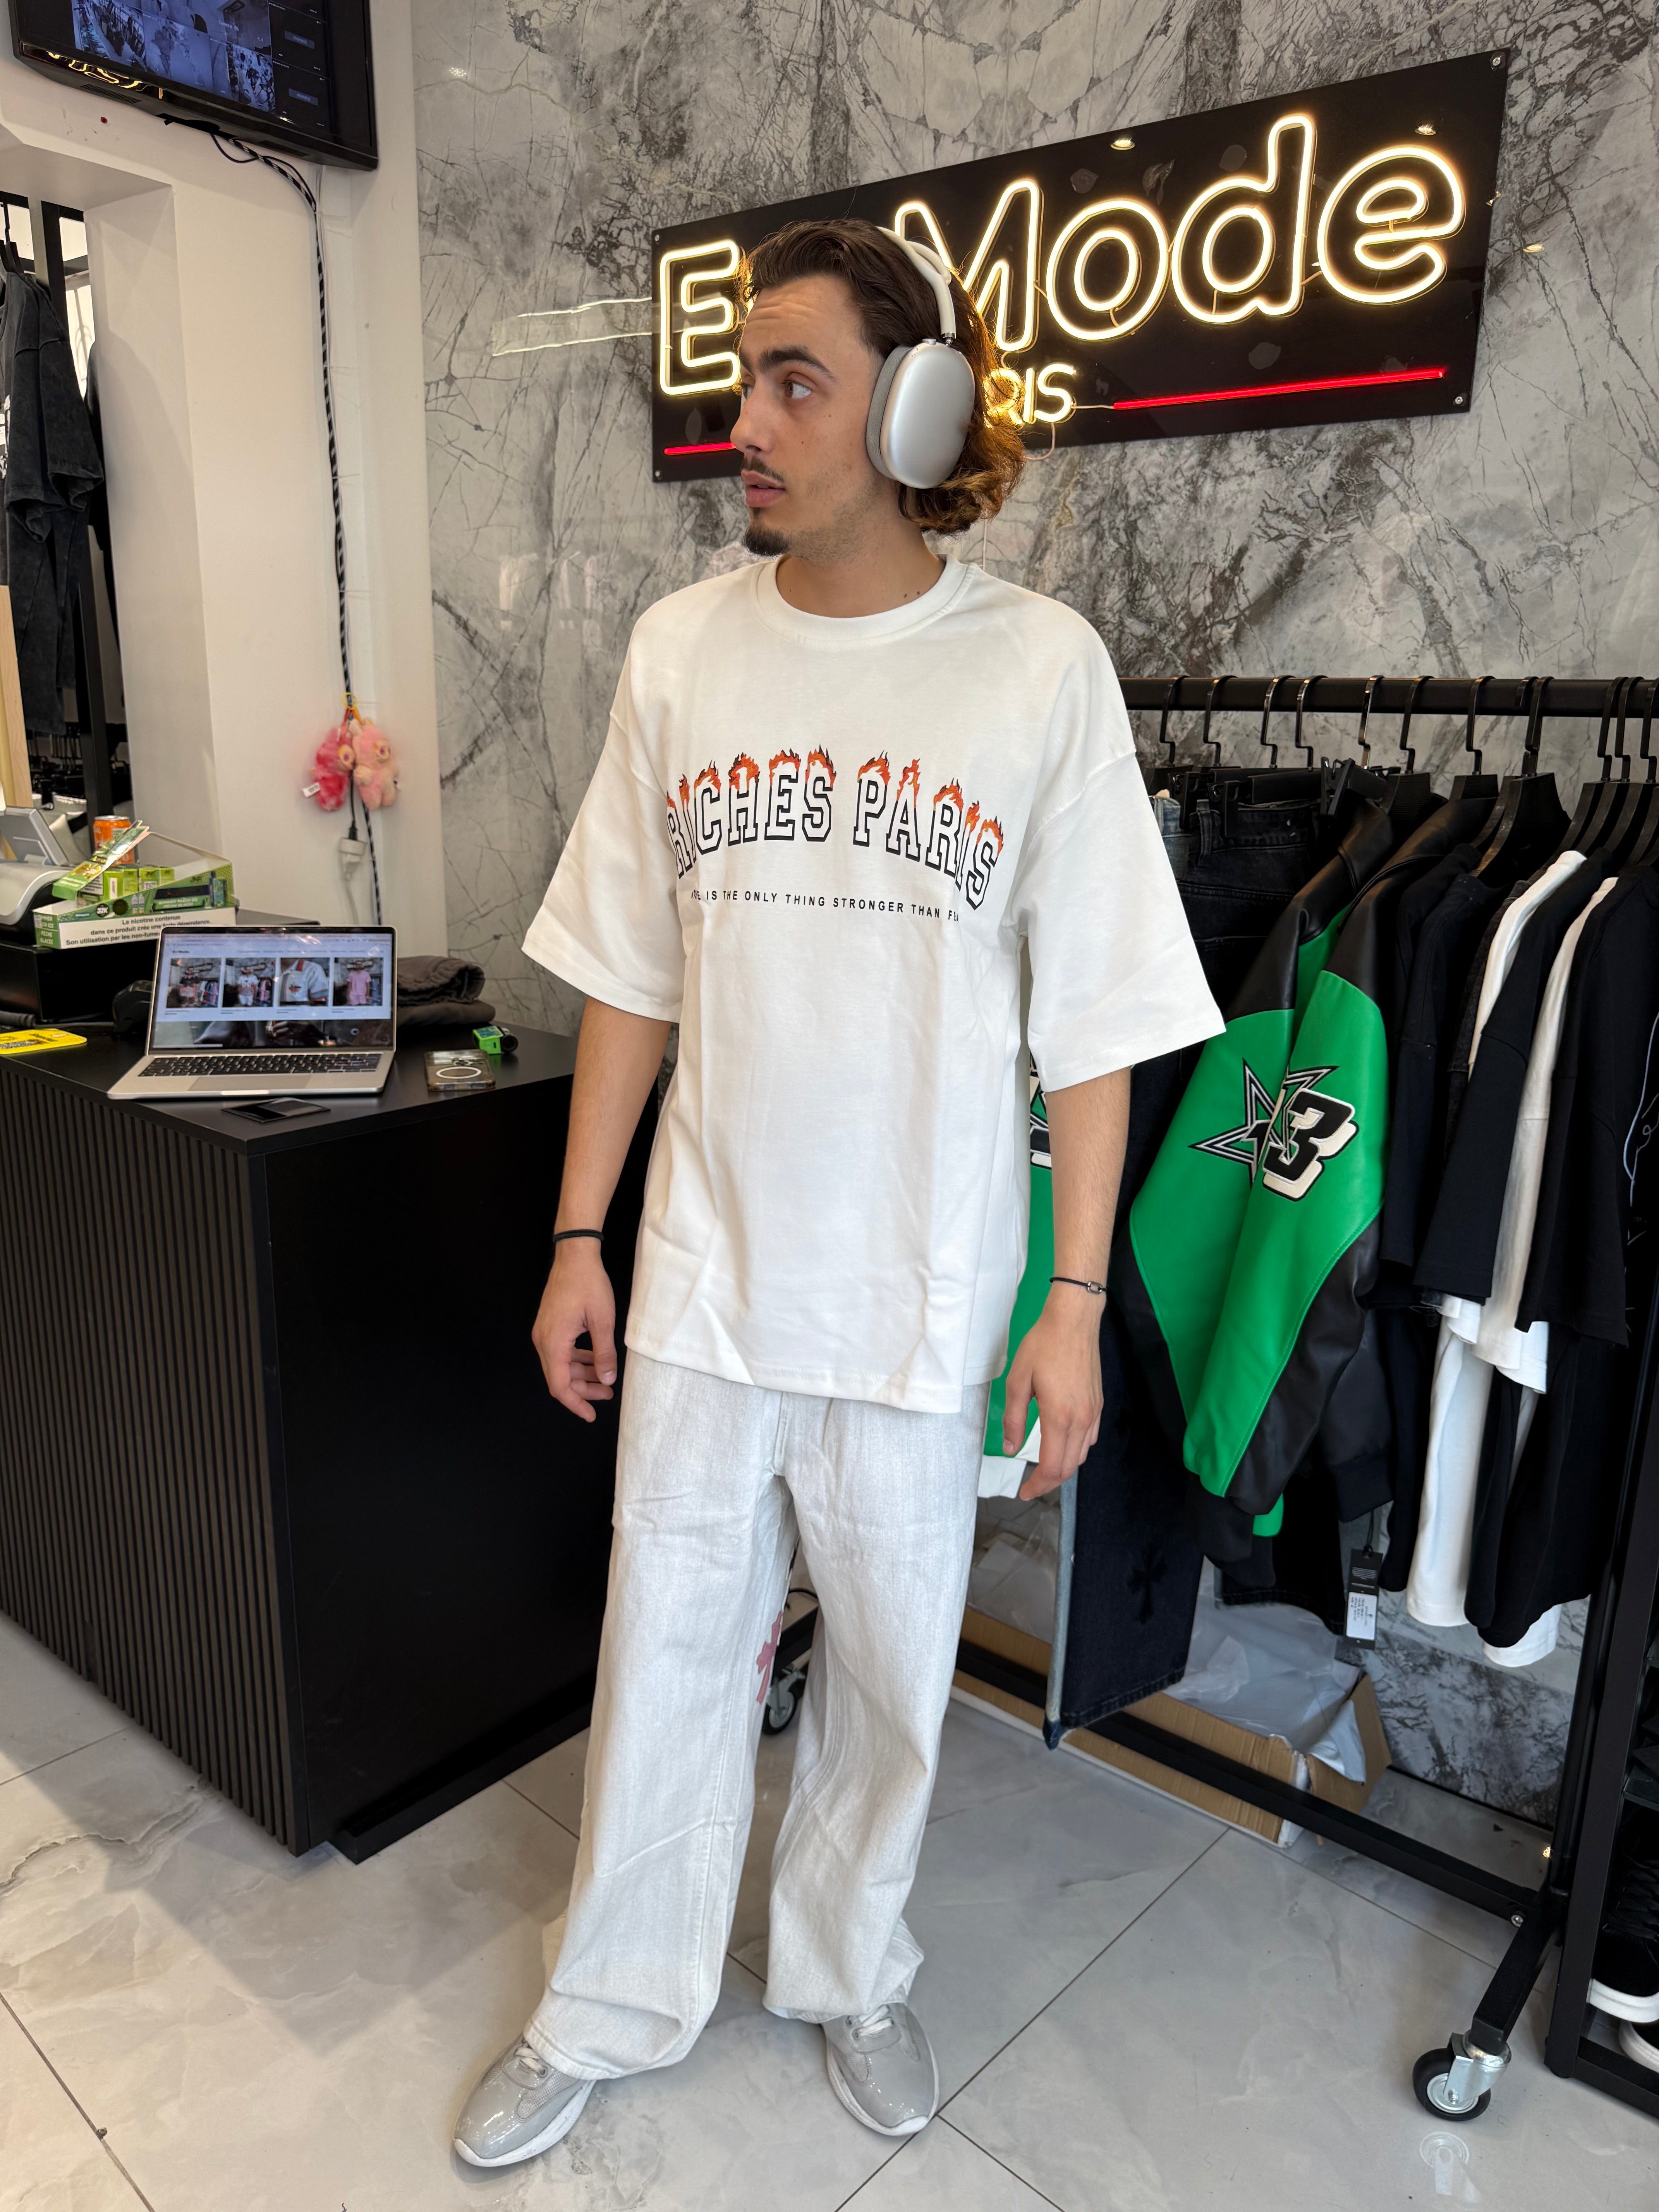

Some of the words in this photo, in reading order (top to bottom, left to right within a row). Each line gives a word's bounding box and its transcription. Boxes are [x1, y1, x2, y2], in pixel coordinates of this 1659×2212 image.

[659, 239, 742, 396] E
[893, 114, 1465, 352] Mode
[666, 744, 837, 879] RICHES
[853, 750, 1004, 910] PARIS
[706, 890, 717, 900] IS
[723, 890, 738, 900] THE
[745, 891, 777, 903] ONLY
[785, 894, 825, 907] THING
[833, 897, 903, 913] STRONGER
[911, 904, 940, 919] THAN
